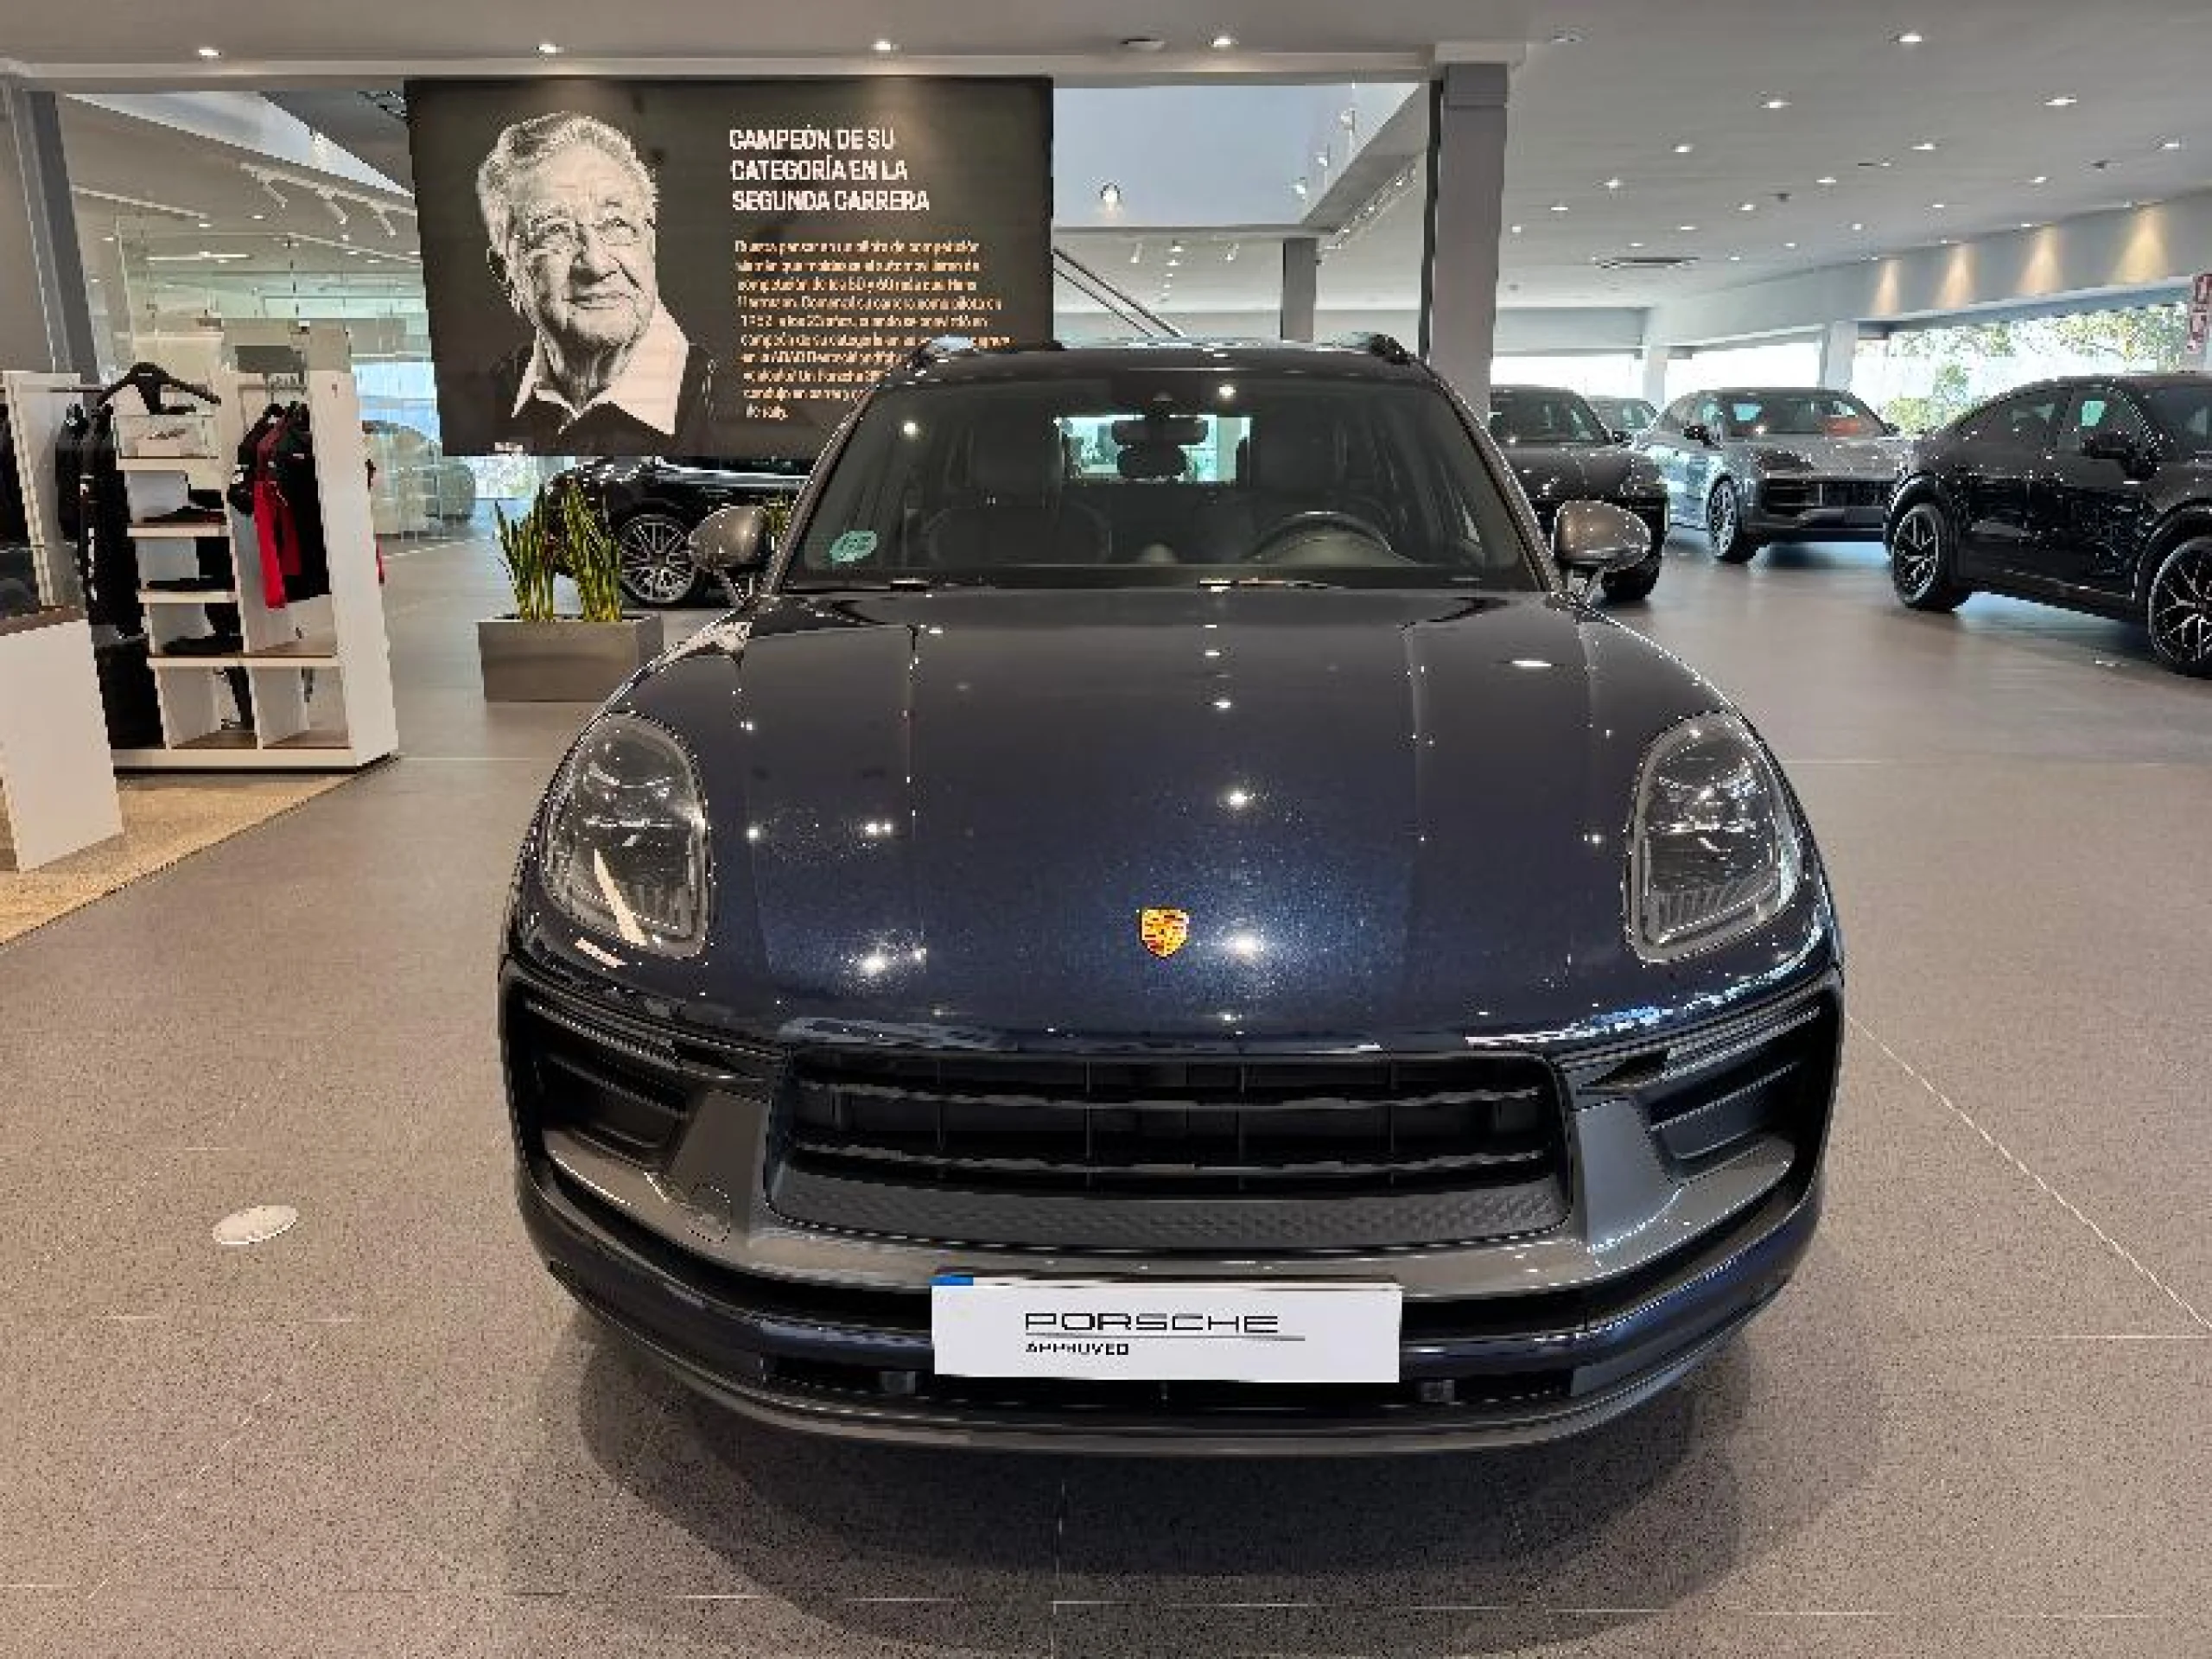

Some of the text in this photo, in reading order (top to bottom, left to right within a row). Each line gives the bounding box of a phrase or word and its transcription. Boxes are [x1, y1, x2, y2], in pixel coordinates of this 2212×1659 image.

[729, 125, 895, 150] CAMPEÓN DE SU
[730, 156, 908, 181] CATEGORÍA EN LA
[732, 190, 930, 211] SEGUNDA CARRERA
[1025, 1313, 1279, 1333] PORSCHE
[1026, 1342, 1129, 1356] APPROVED
